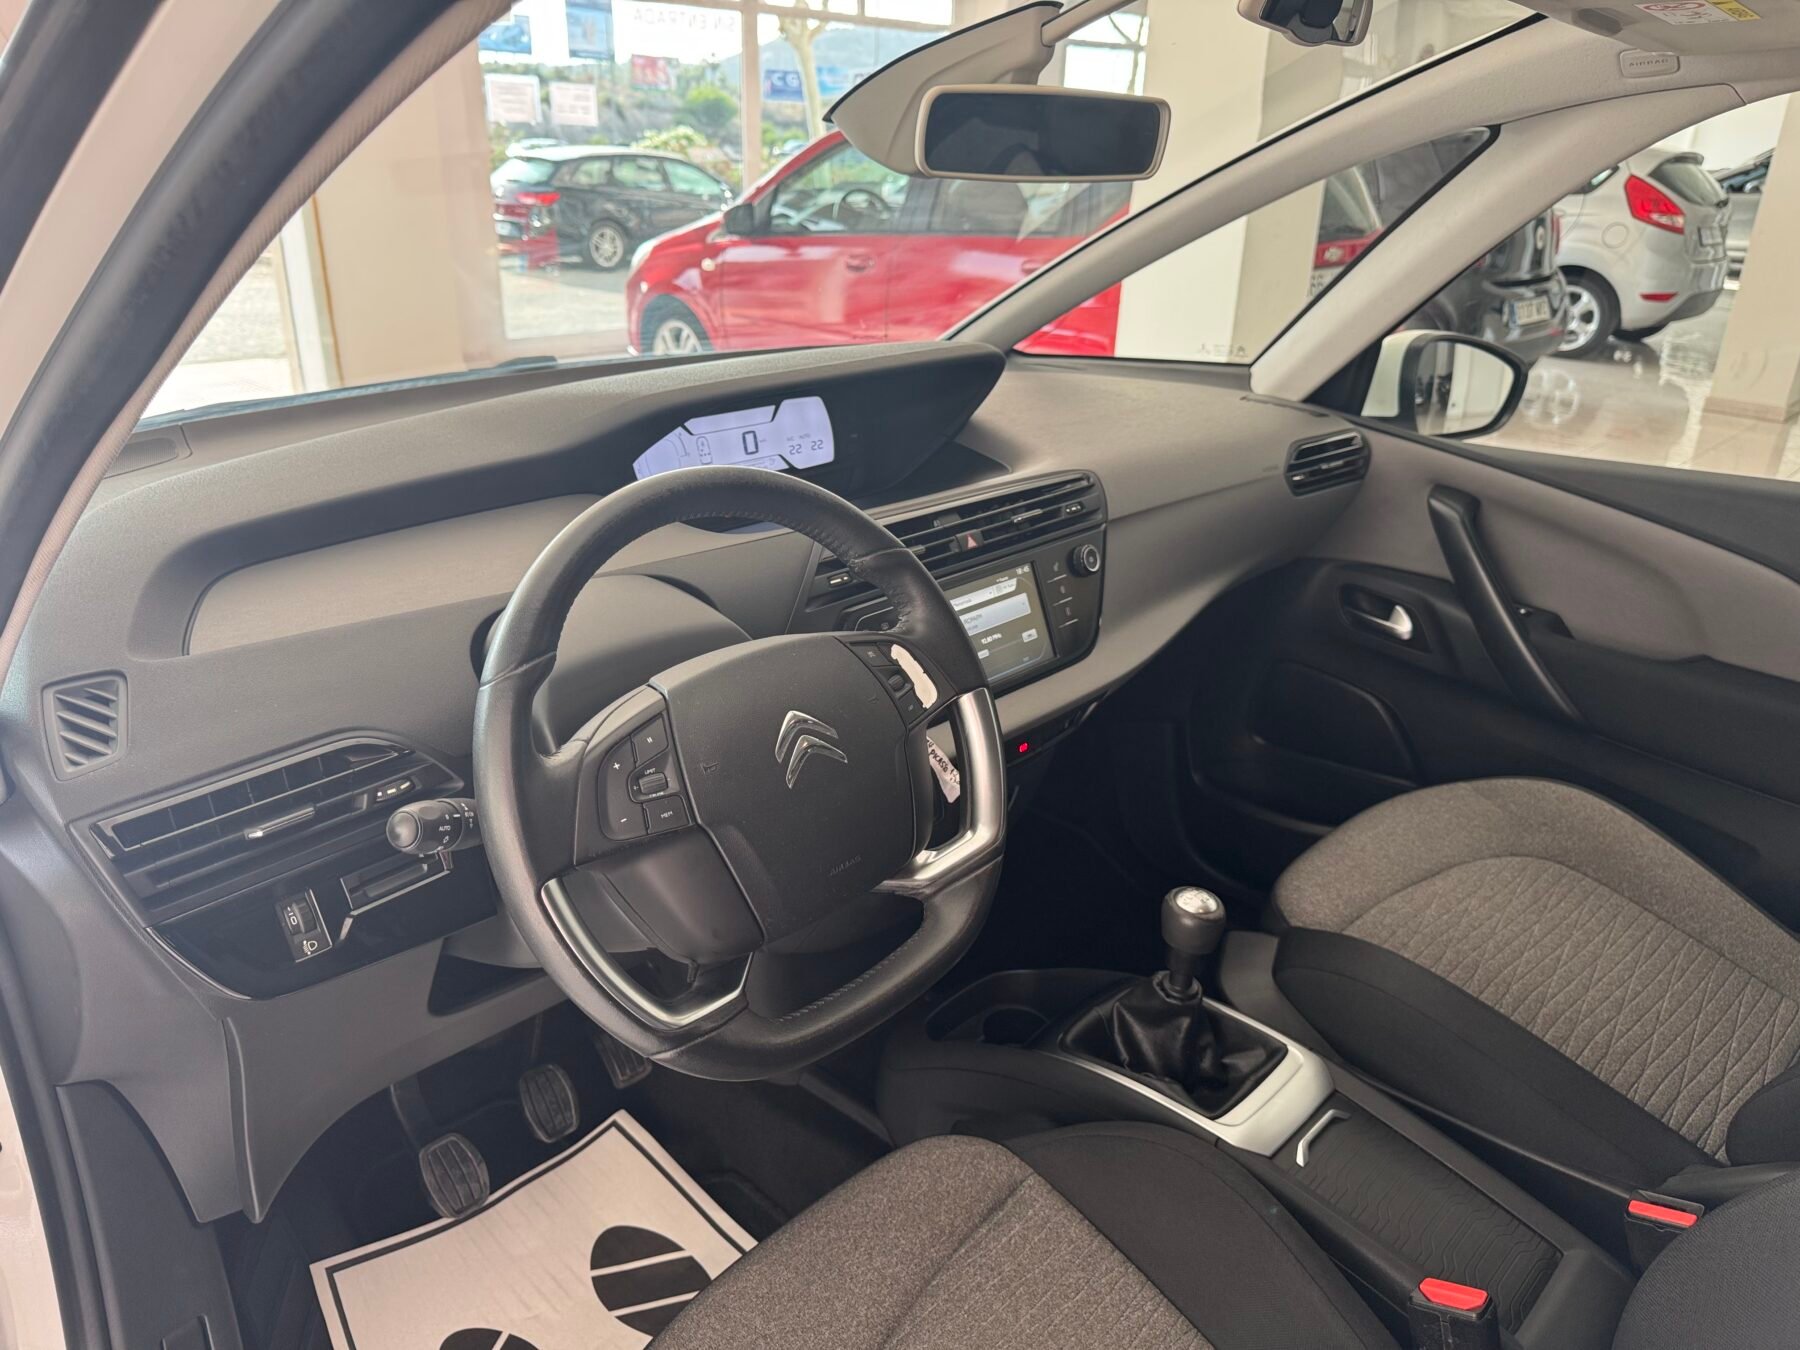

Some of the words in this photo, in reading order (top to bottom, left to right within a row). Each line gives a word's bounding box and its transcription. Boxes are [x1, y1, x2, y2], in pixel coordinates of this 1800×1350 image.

[742, 430, 759, 455] 0
[788, 443, 802, 455] 22
[810, 439, 824, 451] 22
